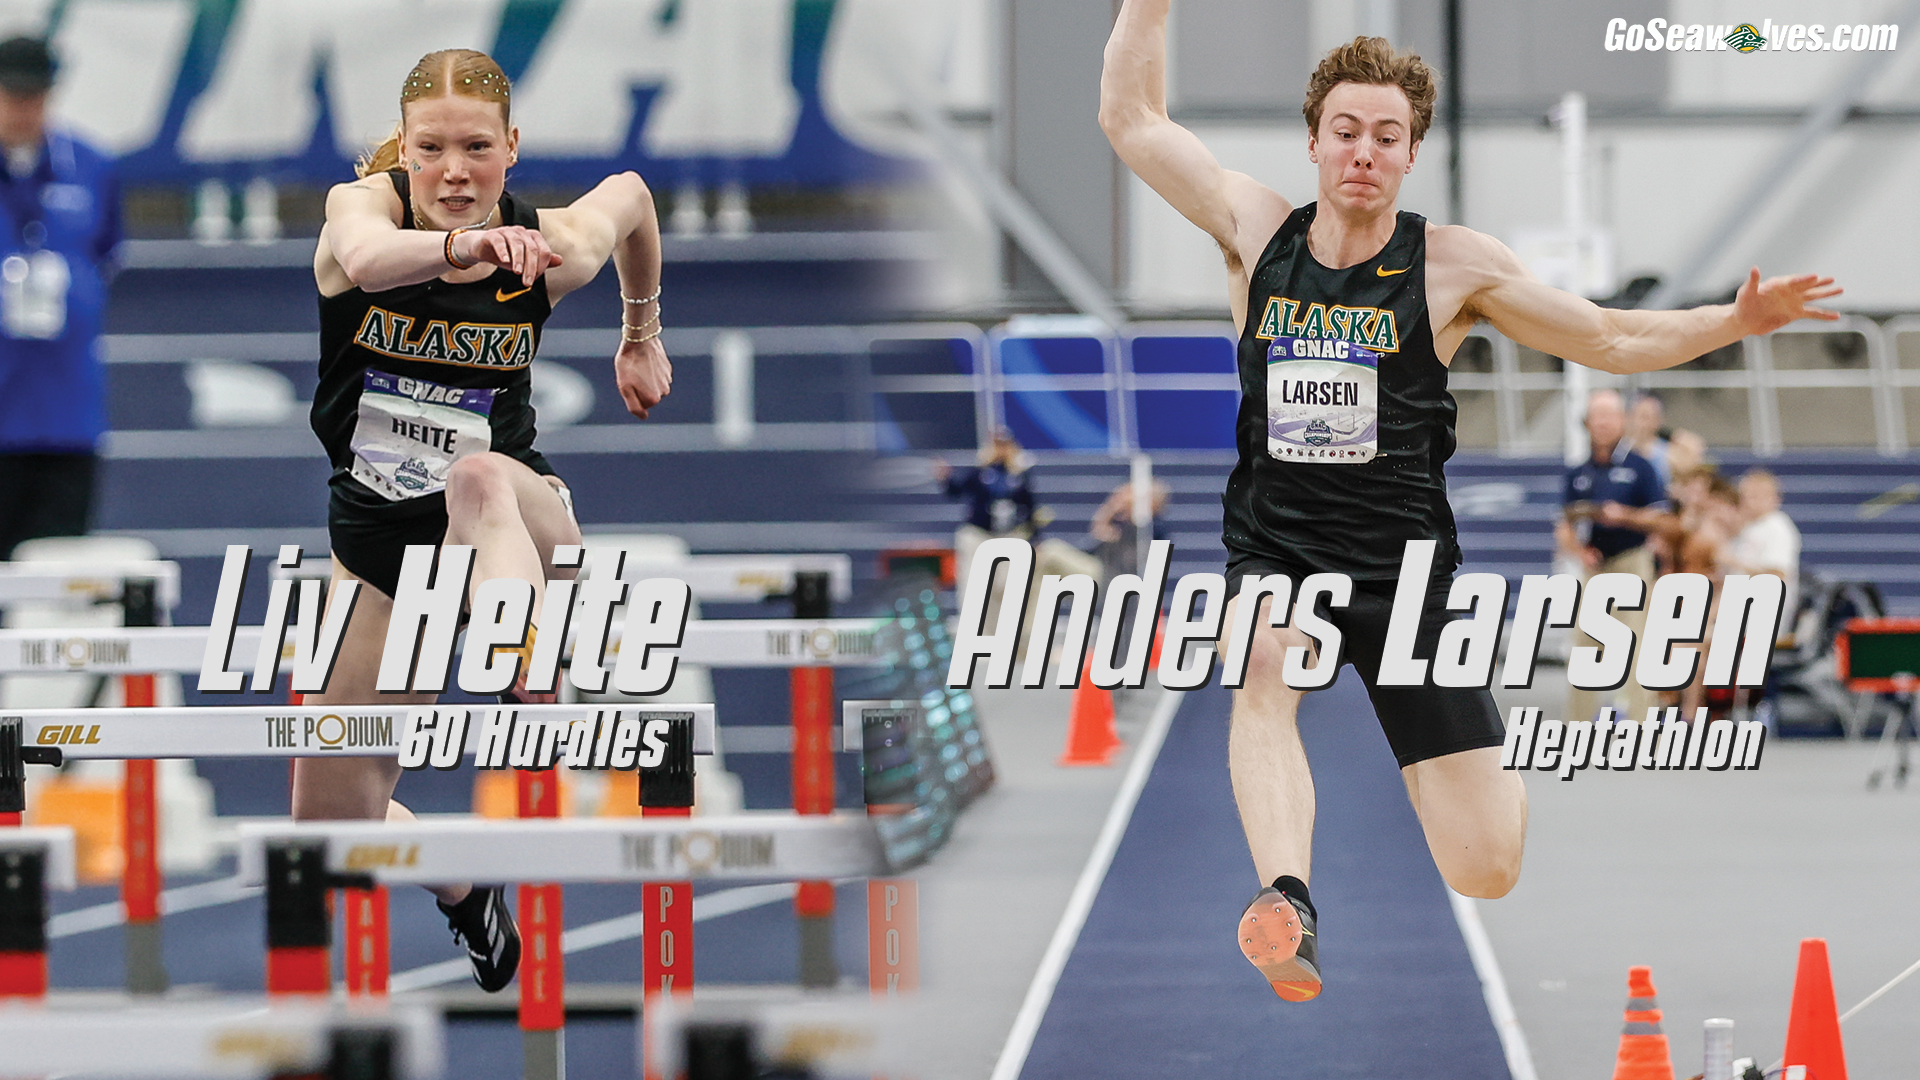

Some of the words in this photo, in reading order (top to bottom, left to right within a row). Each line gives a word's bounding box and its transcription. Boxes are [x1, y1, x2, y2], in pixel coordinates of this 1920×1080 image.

[353, 305, 535, 371] ALASKA
[1256, 296, 1400, 353] ALASKA
[1292, 339, 1350, 359] GNAC
[397, 377, 465, 404] GNAC
[1282, 379, 1358, 406] LARSEN
[392, 417, 458, 454] HEITE
[37, 724, 101, 745] GILL
[265, 717, 297, 748] THE
